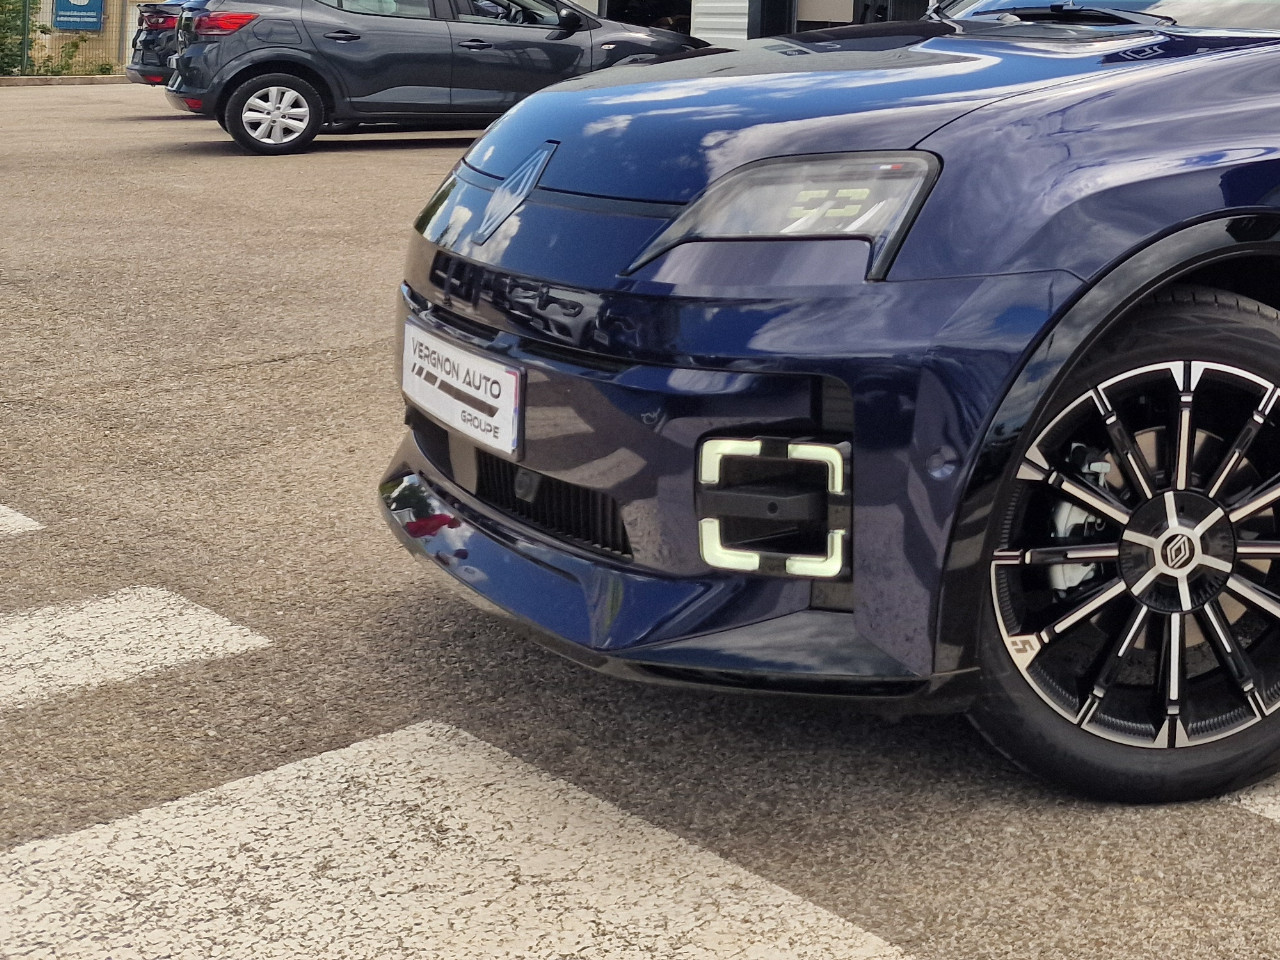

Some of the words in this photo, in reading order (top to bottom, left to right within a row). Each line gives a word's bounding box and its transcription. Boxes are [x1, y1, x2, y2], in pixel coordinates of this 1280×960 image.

[411, 337, 459, 382] VERGNON
[463, 368, 501, 399] AUTO
[461, 410, 499, 439] GROUPE
